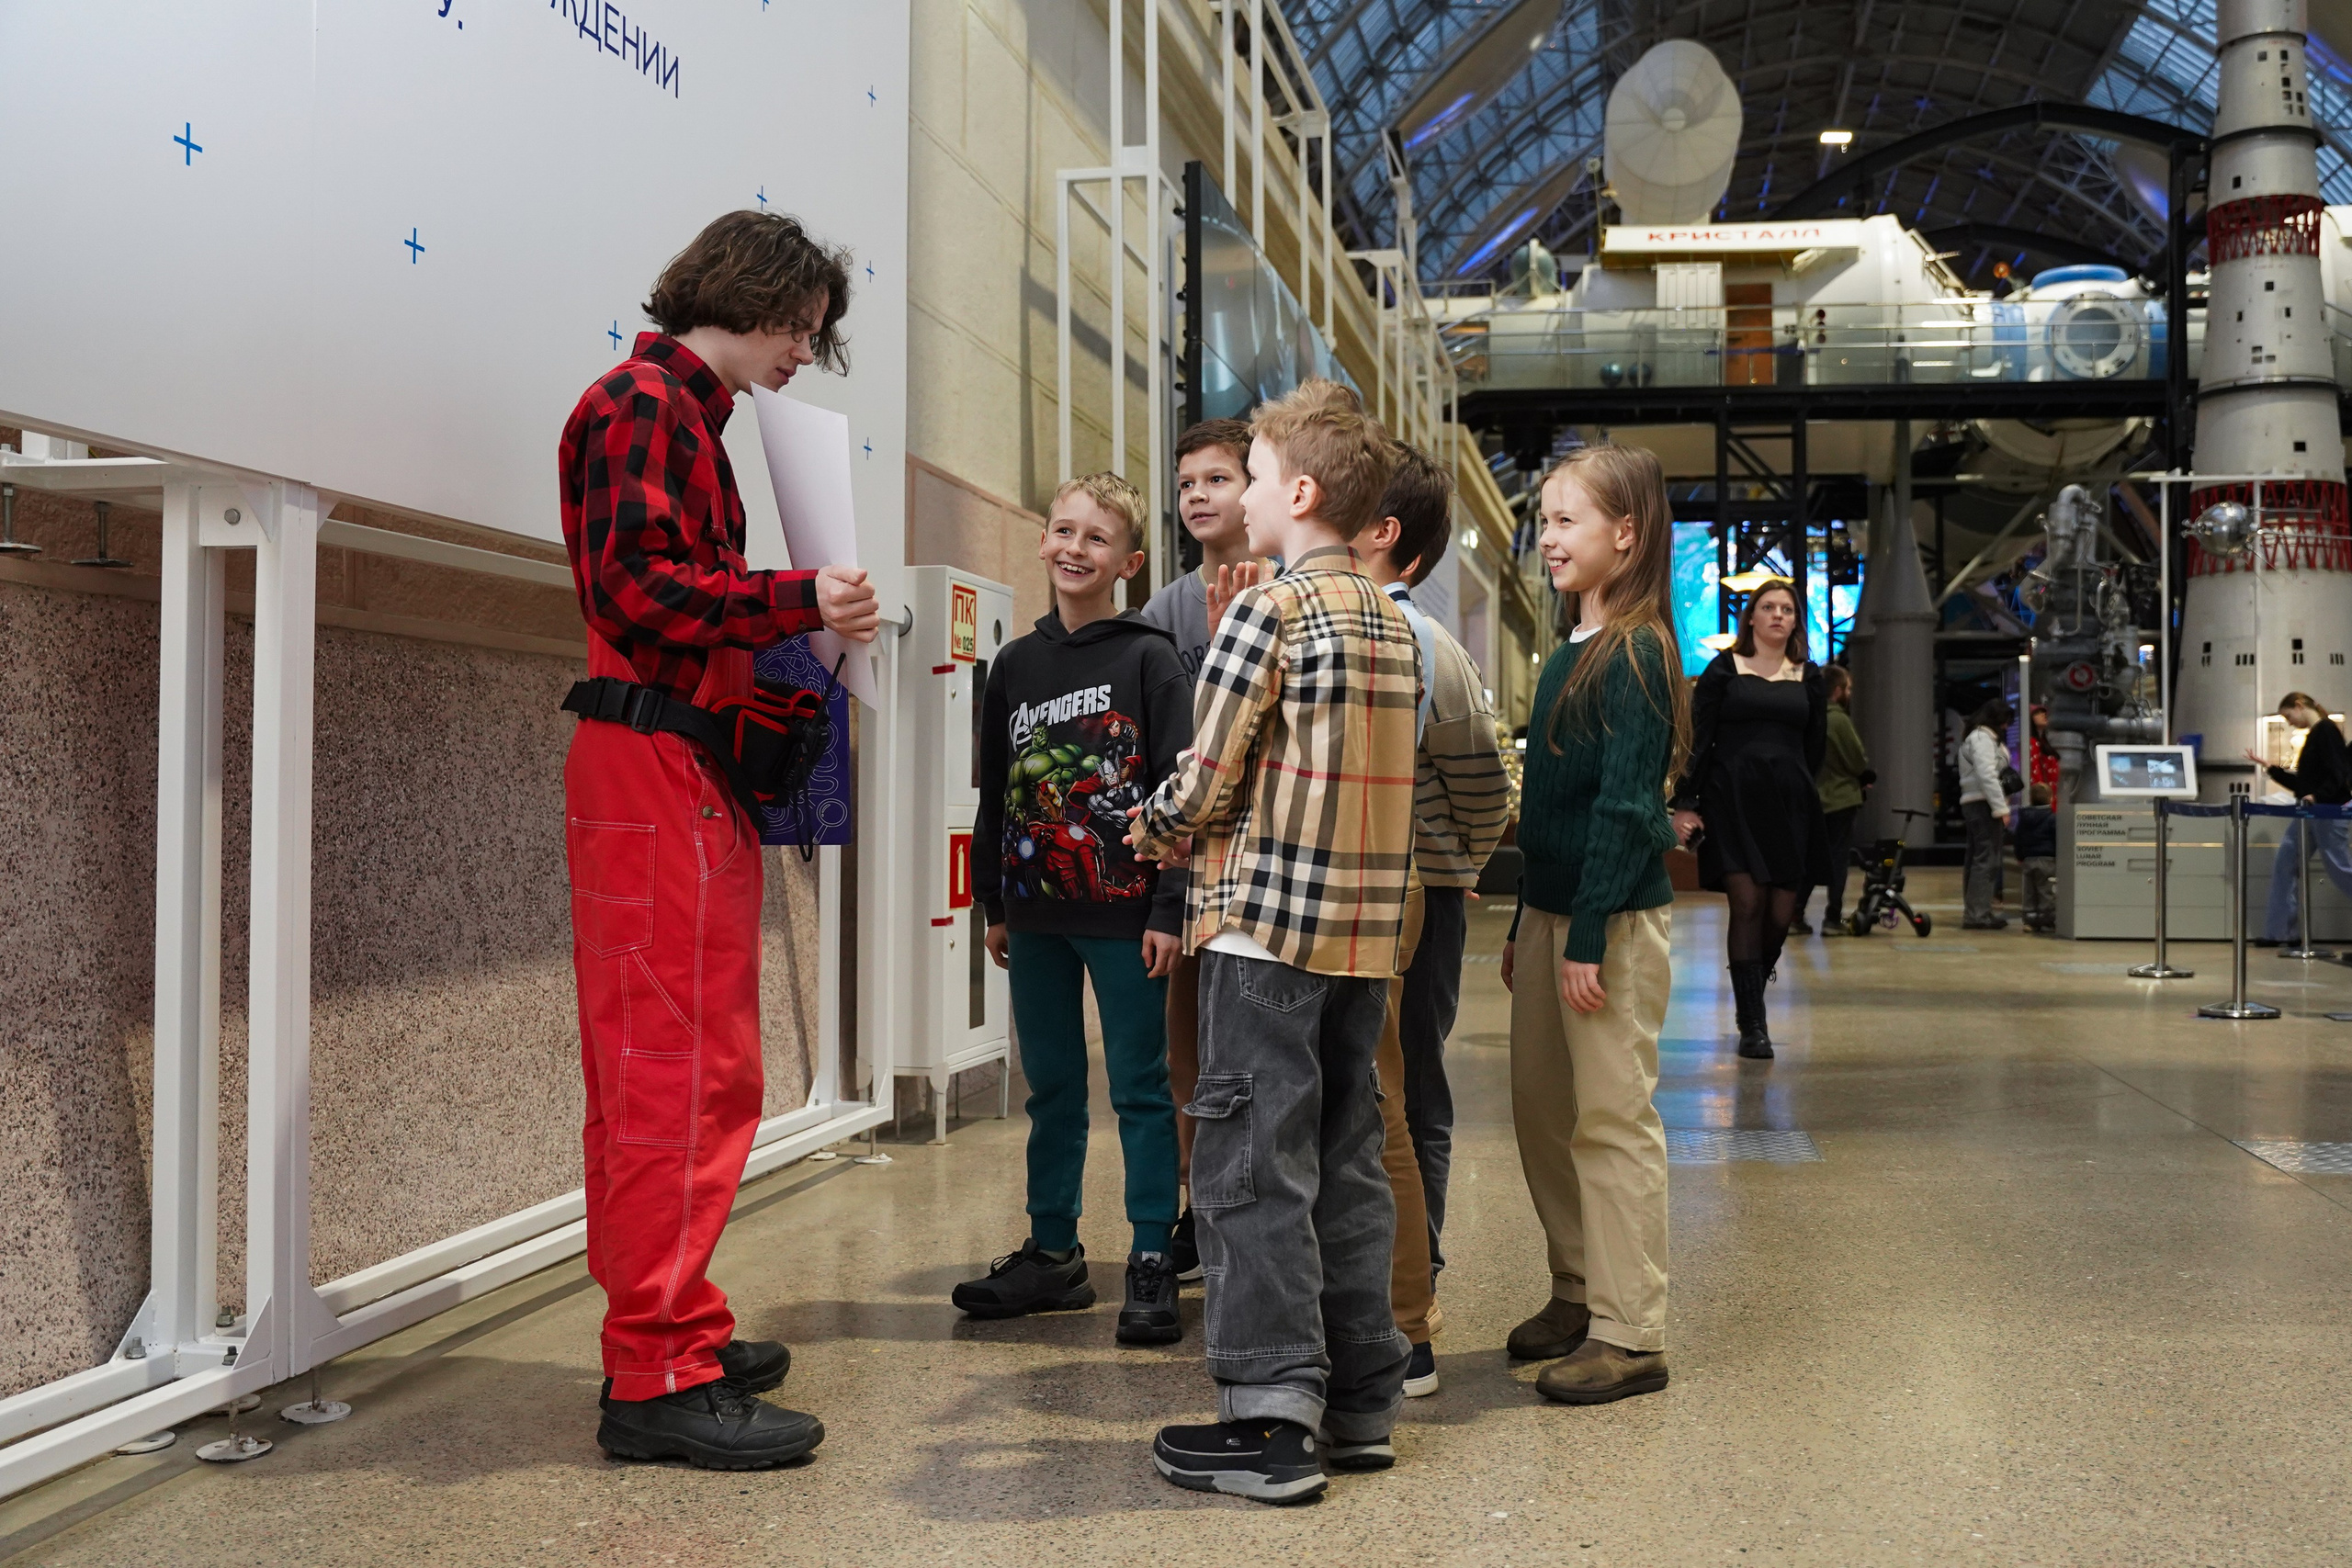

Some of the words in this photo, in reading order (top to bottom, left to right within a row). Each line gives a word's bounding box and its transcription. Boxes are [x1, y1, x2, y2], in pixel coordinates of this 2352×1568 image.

[1648, 229, 1820, 242] КРИСТАЛЛ
[955, 593, 974, 626] ПК
[962, 636, 973, 652] 025
[1181, 640, 1211, 674] OR
[1009, 684, 1112, 751] AVENGERS
